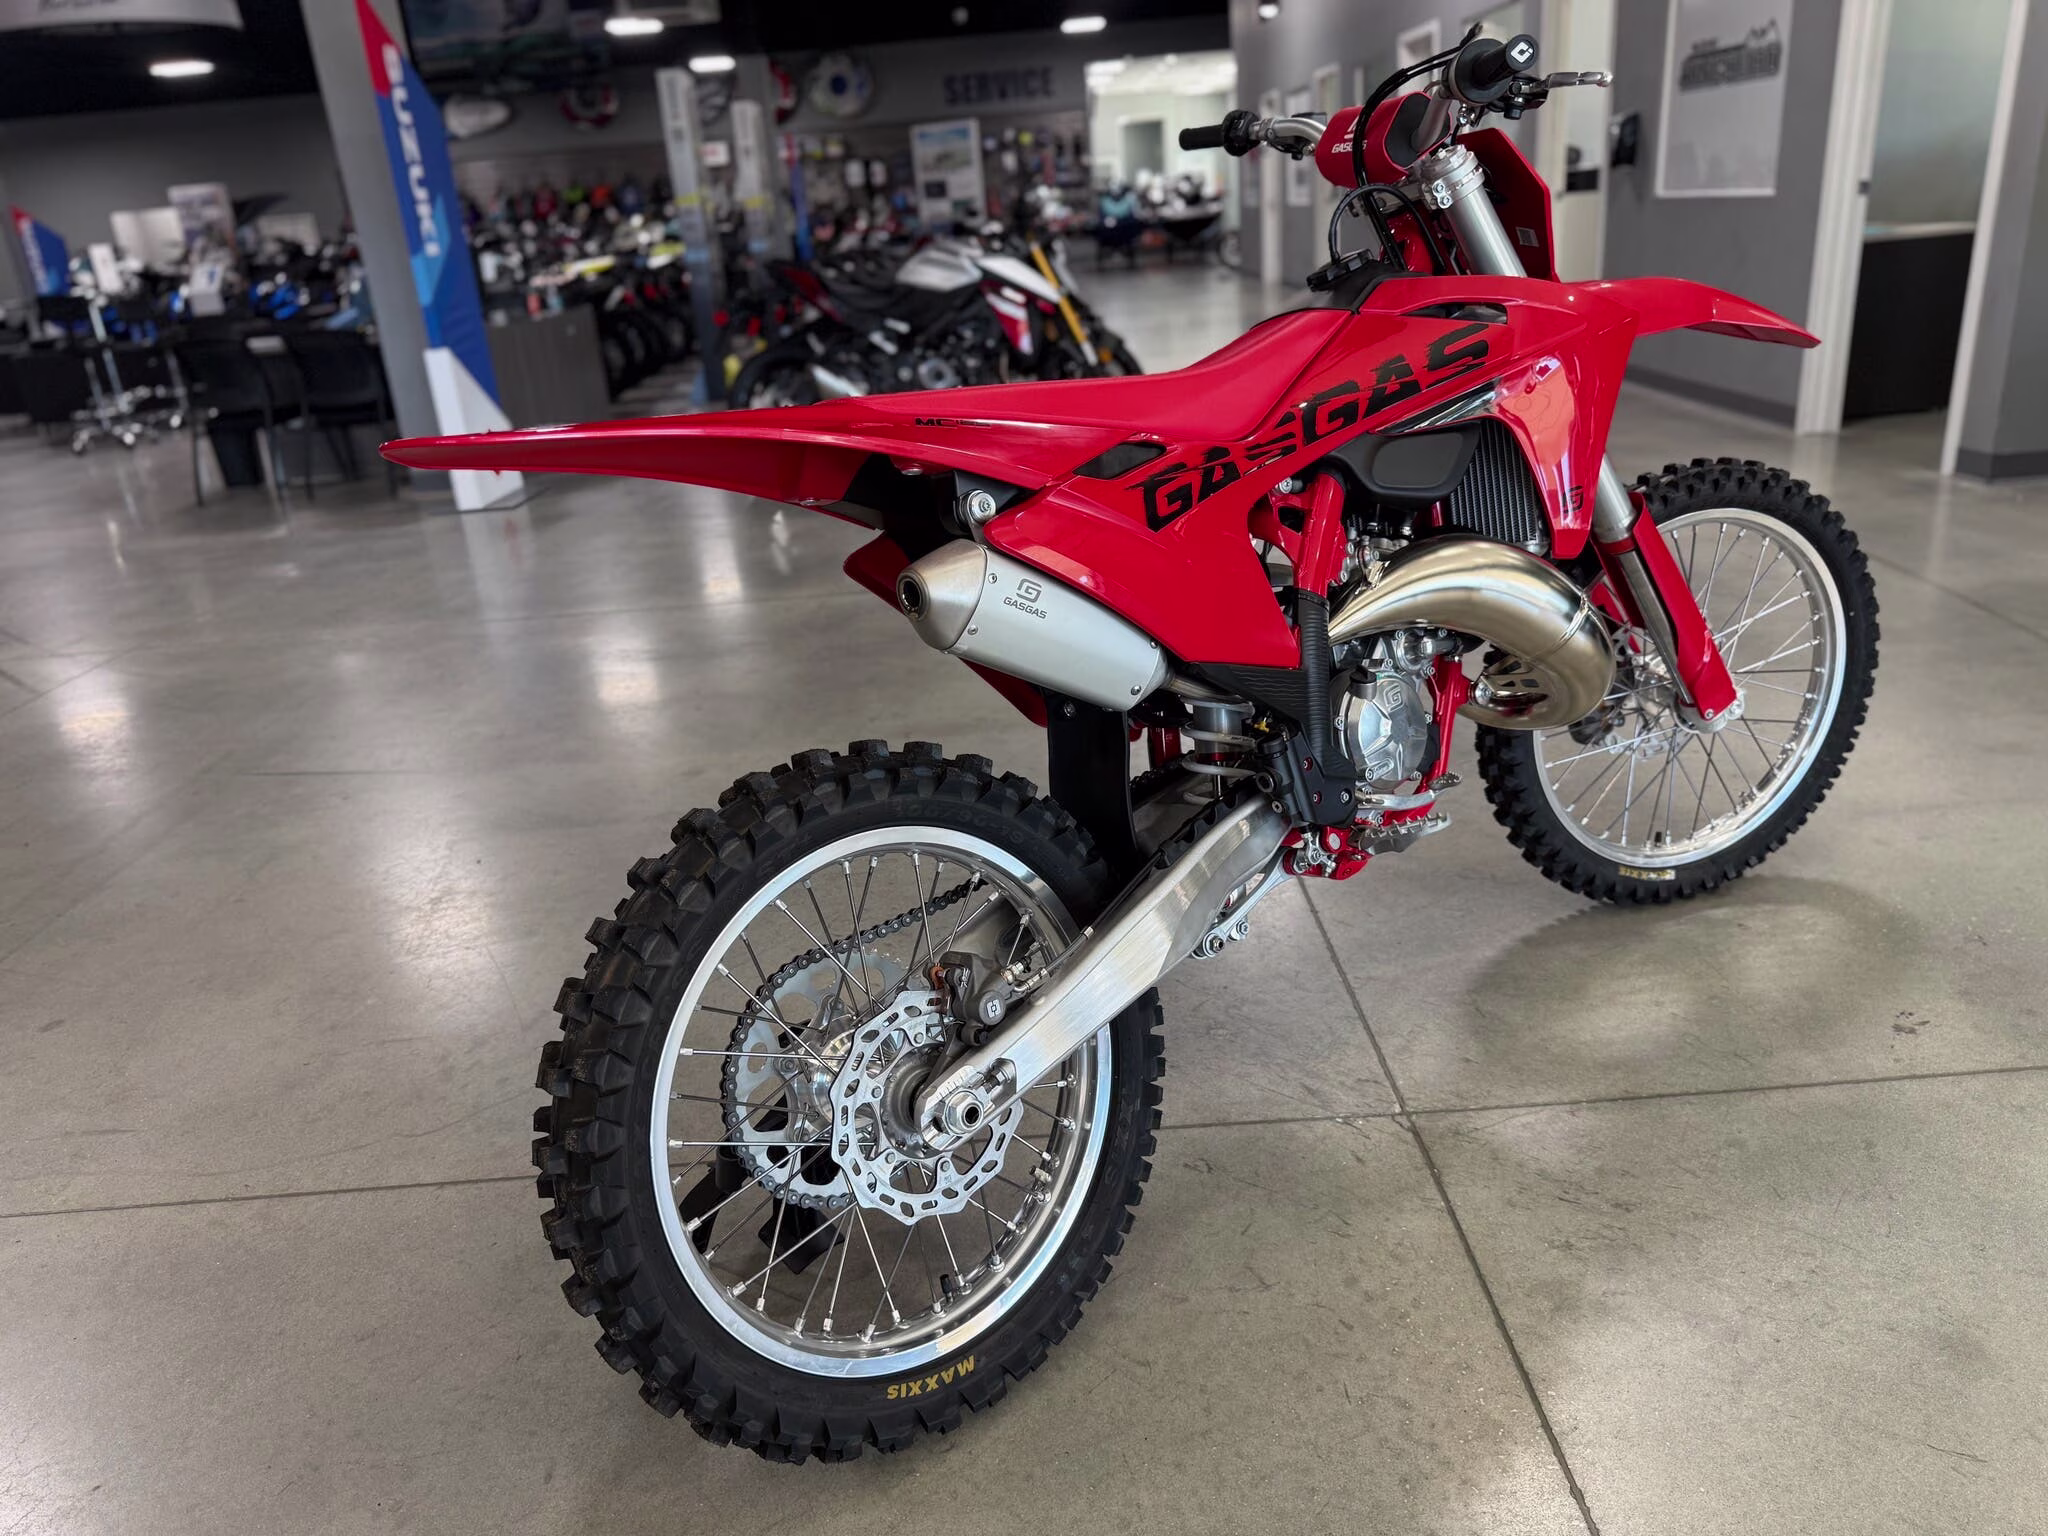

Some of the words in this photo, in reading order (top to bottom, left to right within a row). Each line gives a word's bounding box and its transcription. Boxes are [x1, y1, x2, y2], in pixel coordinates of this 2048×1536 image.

[381, 43, 441, 257] SUZUKI
[1128, 323, 1490, 533] GASGAS
[1003, 596, 1048, 619] GASGAS
[886, 1355, 975, 1400] MAXXIS
